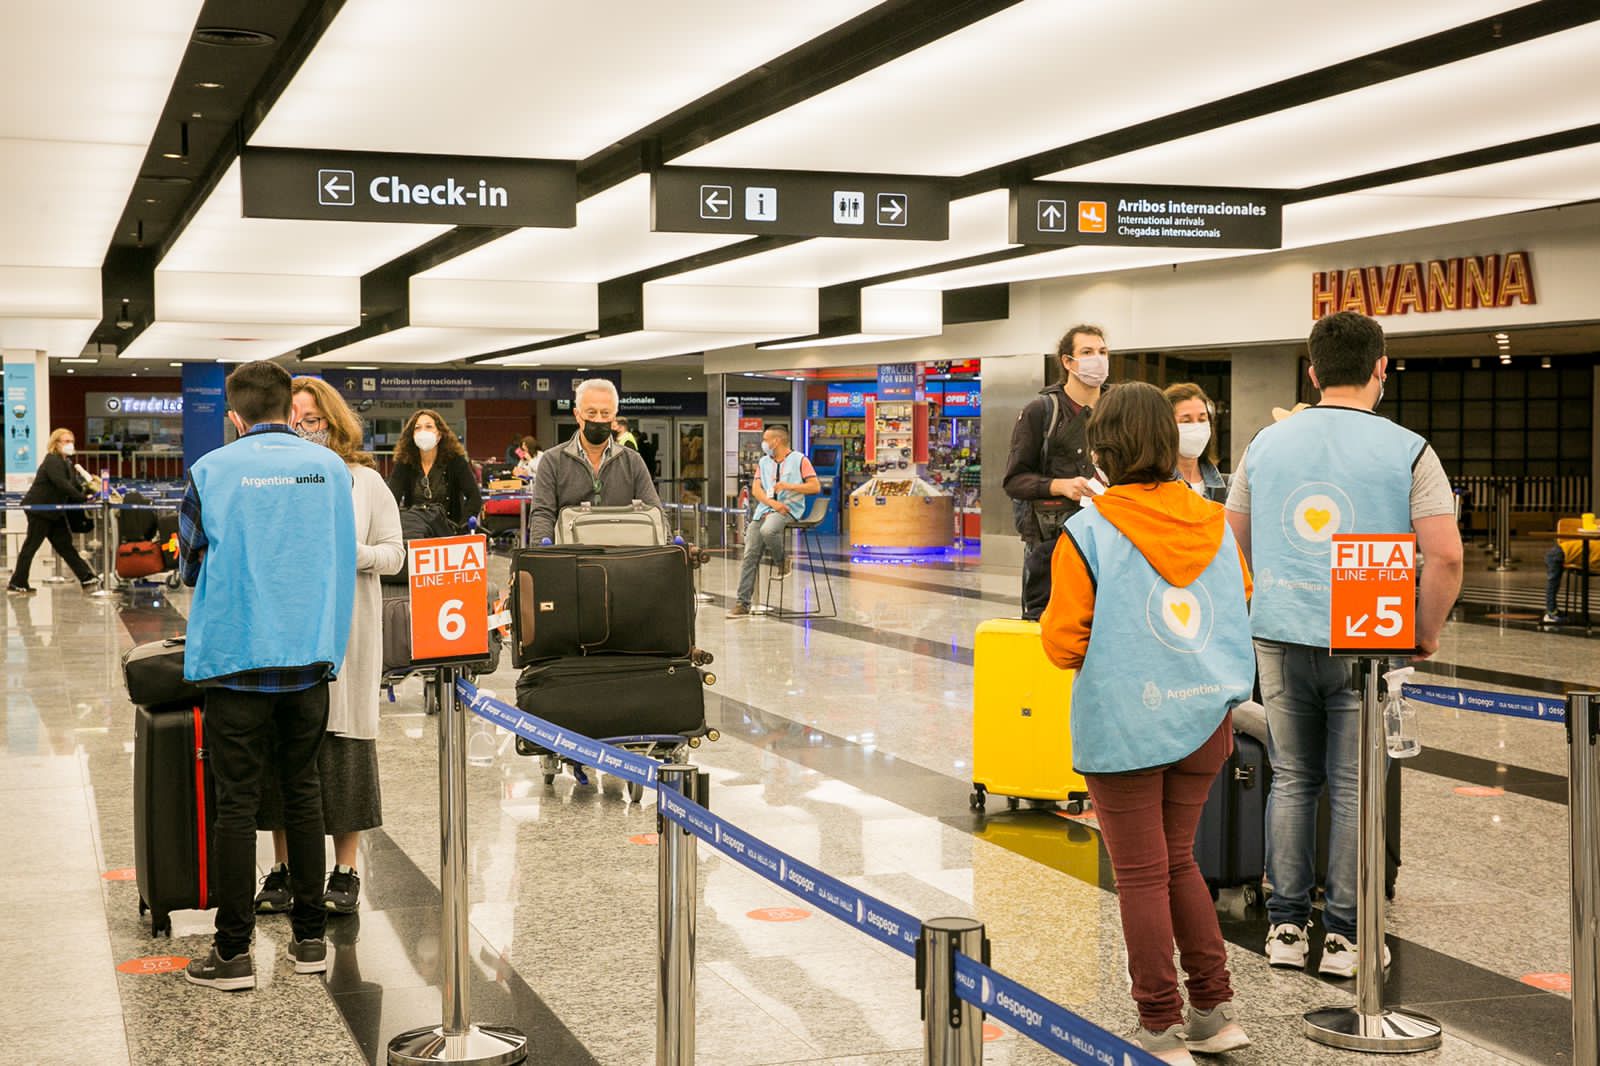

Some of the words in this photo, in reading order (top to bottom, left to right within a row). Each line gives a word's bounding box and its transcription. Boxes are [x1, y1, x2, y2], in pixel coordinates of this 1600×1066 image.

[369, 176, 508, 207] Check-in
[1118, 199, 1166, 214] Arribos
[1168, 202, 1267, 216] internacionales
[1118, 215, 1173, 226] International
[1174, 216, 1205, 226] arrivals
[1118, 226, 1160, 237] Chegadas
[1161, 227, 1221, 238] internacionais
[1312, 251, 1537, 320] HAVANNA
[880, 364, 913, 375] GRACIAS
[380, 377, 410, 386] Arribos
[411, 377, 473, 386] internacionales
[880, 375, 893, 383] POR
[894, 375, 914, 383] VENIR
[619, 396, 656, 404] acionales
[415, 545, 480, 573] FILA
[1337, 543, 1408, 567] FILA
[415, 574, 445, 588] LINE
[454, 571, 481, 583] FILA
[1336, 569, 1368, 581] LINE
[1378, 569, 1409, 581] FILA
[438, 599, 467, 641] 6
[1374, 596, 1403, 637] 5
[1167, 683, 1221, 700] Argentina
[722, 831, 745, 853] despegar
[788, 869, 815, 893] despegar
[867, 910, 899, 936] despegar
[955, 971, 976, 989] HALLO
[996, 991, 1043, 1027] despegar
[1051, 1024, 1070, 1043] HOLA
[1072, 1035, 1094, 1057] HELLO
[1097, 1050, 1115, 1066] CIAO
